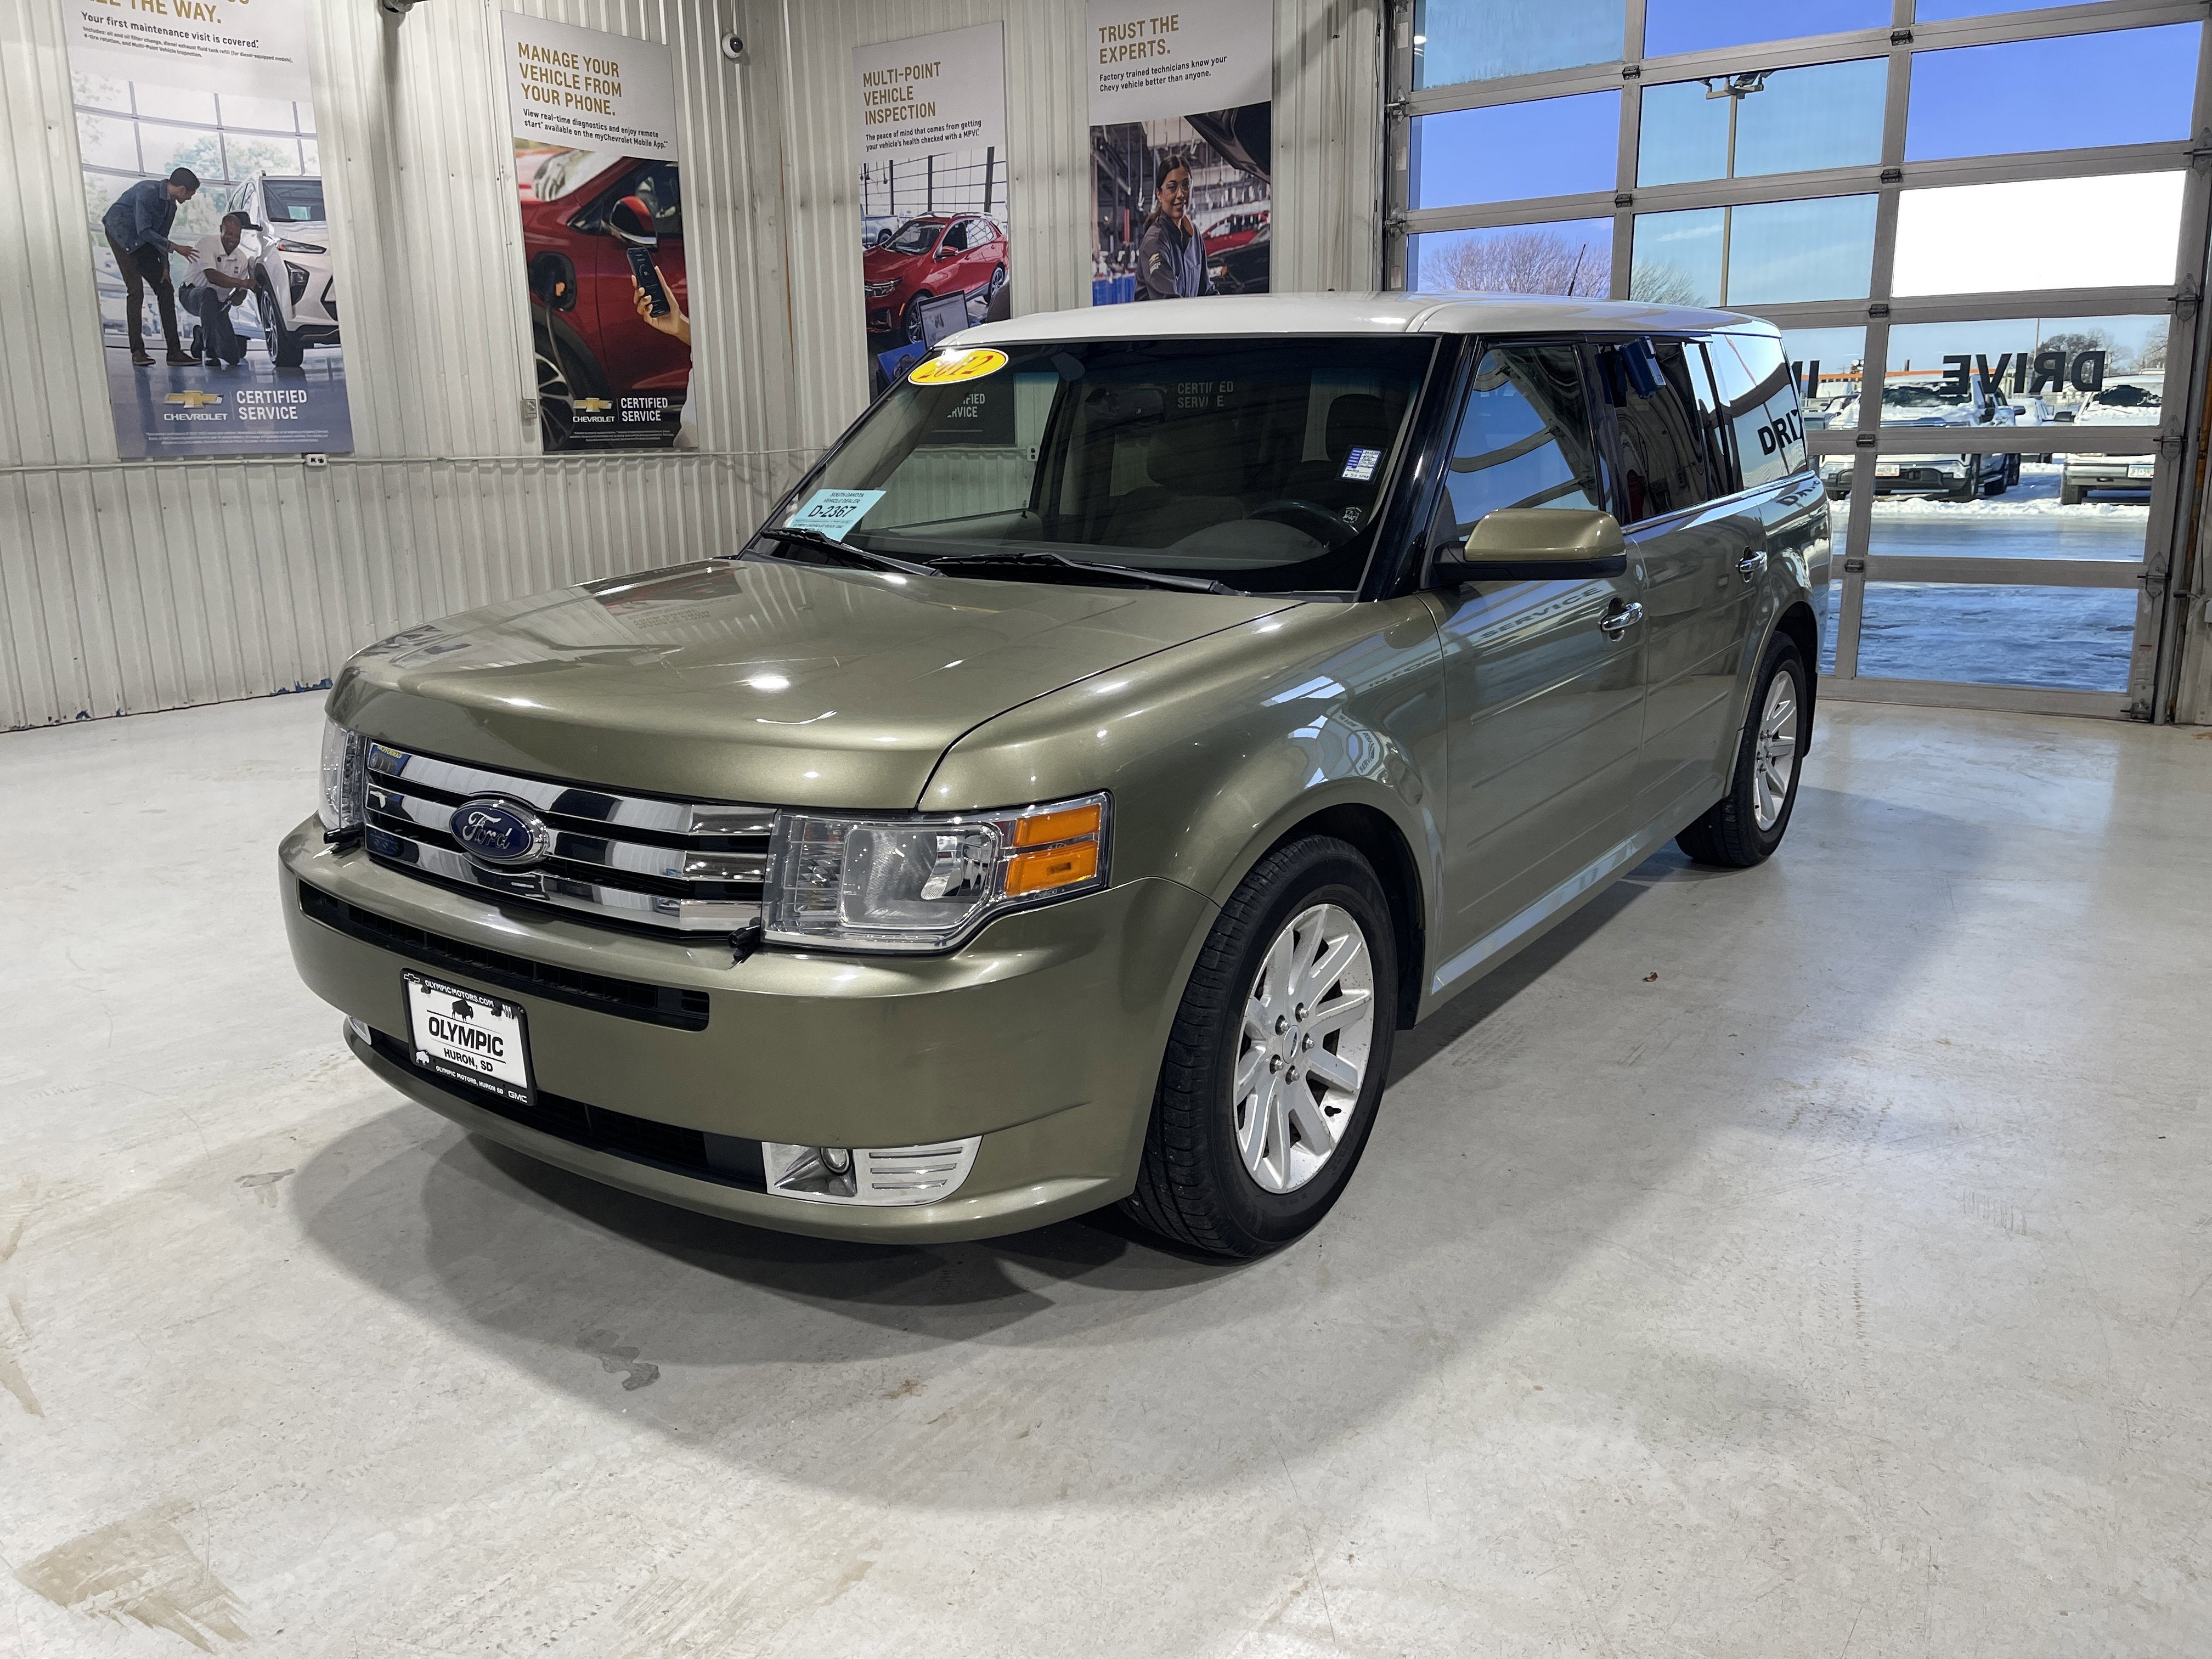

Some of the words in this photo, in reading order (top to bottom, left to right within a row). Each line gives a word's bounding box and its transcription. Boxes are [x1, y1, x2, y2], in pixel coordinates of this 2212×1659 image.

[173, 0, 221, 24] WAY.
[81, 11, 104, 24] Your
[107, 16, 128, 29] first
[131, 22, 189, 38] maintenance
[191, 32, 211, 42] visit
[213, 34, 220, 43] is
[1098, 20, 1146, 43] TRUST
[1149, 14, 1179, 35] THE
[517, 41, 579, 70] MANAGE
[582, 55, 619, 78] YOUR
[1099, 38, 1171, 64] EXPERTS.
[519, 62, 580, 90] VEHICLE
[584, 76, 622, 98] FROM
[863, 61, 941, 88] MULTI-POINT
[1099, 72, 1124, 81] Factory
[1126, 67, 1149, 78] trained
[1151, 62, 1189, 75] technicians
[1191, 59, 1209, 68] know
[1211, 56, 1227, 66] your
[1099, 83, 1119, 92] Chevy
[1121, 79, 1143, 89] vehicle
[1145, 77, 1166, 86] better
[1168, 75, 1183, 83] than
[1184, 70, 1211, 81] anyone.
[521, 82, 561, 106] YOUR
[565, 92, 616, 116] PHONE.
[864, 85, 913, 106] VEHICLE
[523, 108, 539, 118] View
[540, 112, 571, 124] real-time
[572, 117, 607, 131] diagnostics
[621, 127, 637, 137] enjoy
[865, 101, 936, 126] INSPECTION
[544, 124, 572, 135] available
[583, 130, 593, 138] the
[595, 133, 632, 144] myChevrolet
[634, 138, 652, 147] Mobile
[866, 143, 878, 152] your
[879, 139, 901, 149] vehicle's
[902, 137, 920, 146] health
[921, 134, 944, 144] checked
[945, 132, 957, 140] with
[877, 132, 892, 142] peace
[893, 129, 899, 138] of
[900, 128, 913, 137] mind
[914, 127, 926, 135] that
[961, 119, 981, 130] getting
[236, 390, 308, 404] CERTIFIED
[1177, 381, 1234, 394] CERTIFED
[238, 406, 298, 420] SERVICE
[620, 397, 668, 409] CERTIFIED
[1177, 395, 1224, 408] SERVIE
[622, 410, 662, 422] SERVICE
[808, 505, 857, 517] D-2367
[462, 811, 512, 850] Ford
[425, 980, 494, 1007] OLYMPICMOTORS.COM
[428, 1017, 504, 1057] OLYMPIC
[443, 1047, 478, 1070] HURON,
[480, 1060, 493, 1072] SD
[436, 1065, 456, 1078] OLYMPIC
[456, 1072, 478, 1087] MOTORS,
[479, 1081, 496, 1092] HURON
[496, 1086, 504, 1095] SD
[508, 1090, 528, 1103] GMC
